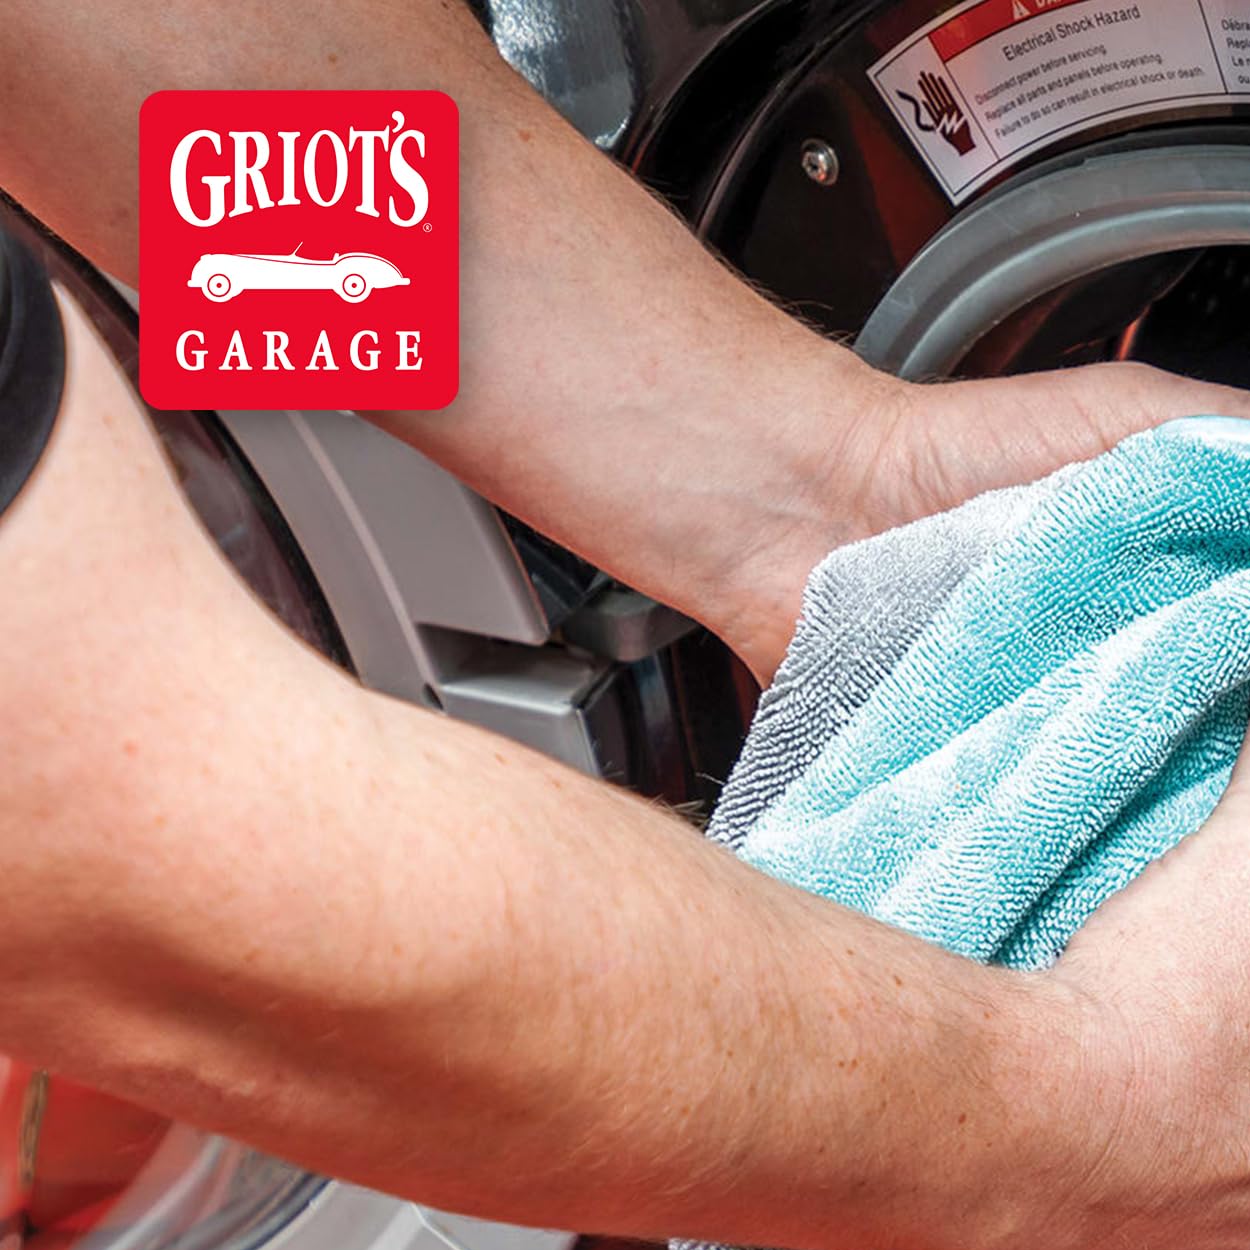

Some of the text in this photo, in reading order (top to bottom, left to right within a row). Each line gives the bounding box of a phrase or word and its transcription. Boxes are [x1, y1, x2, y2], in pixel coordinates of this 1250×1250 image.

[1002, 5, 1141, 61] Electrical Shock Hazard
